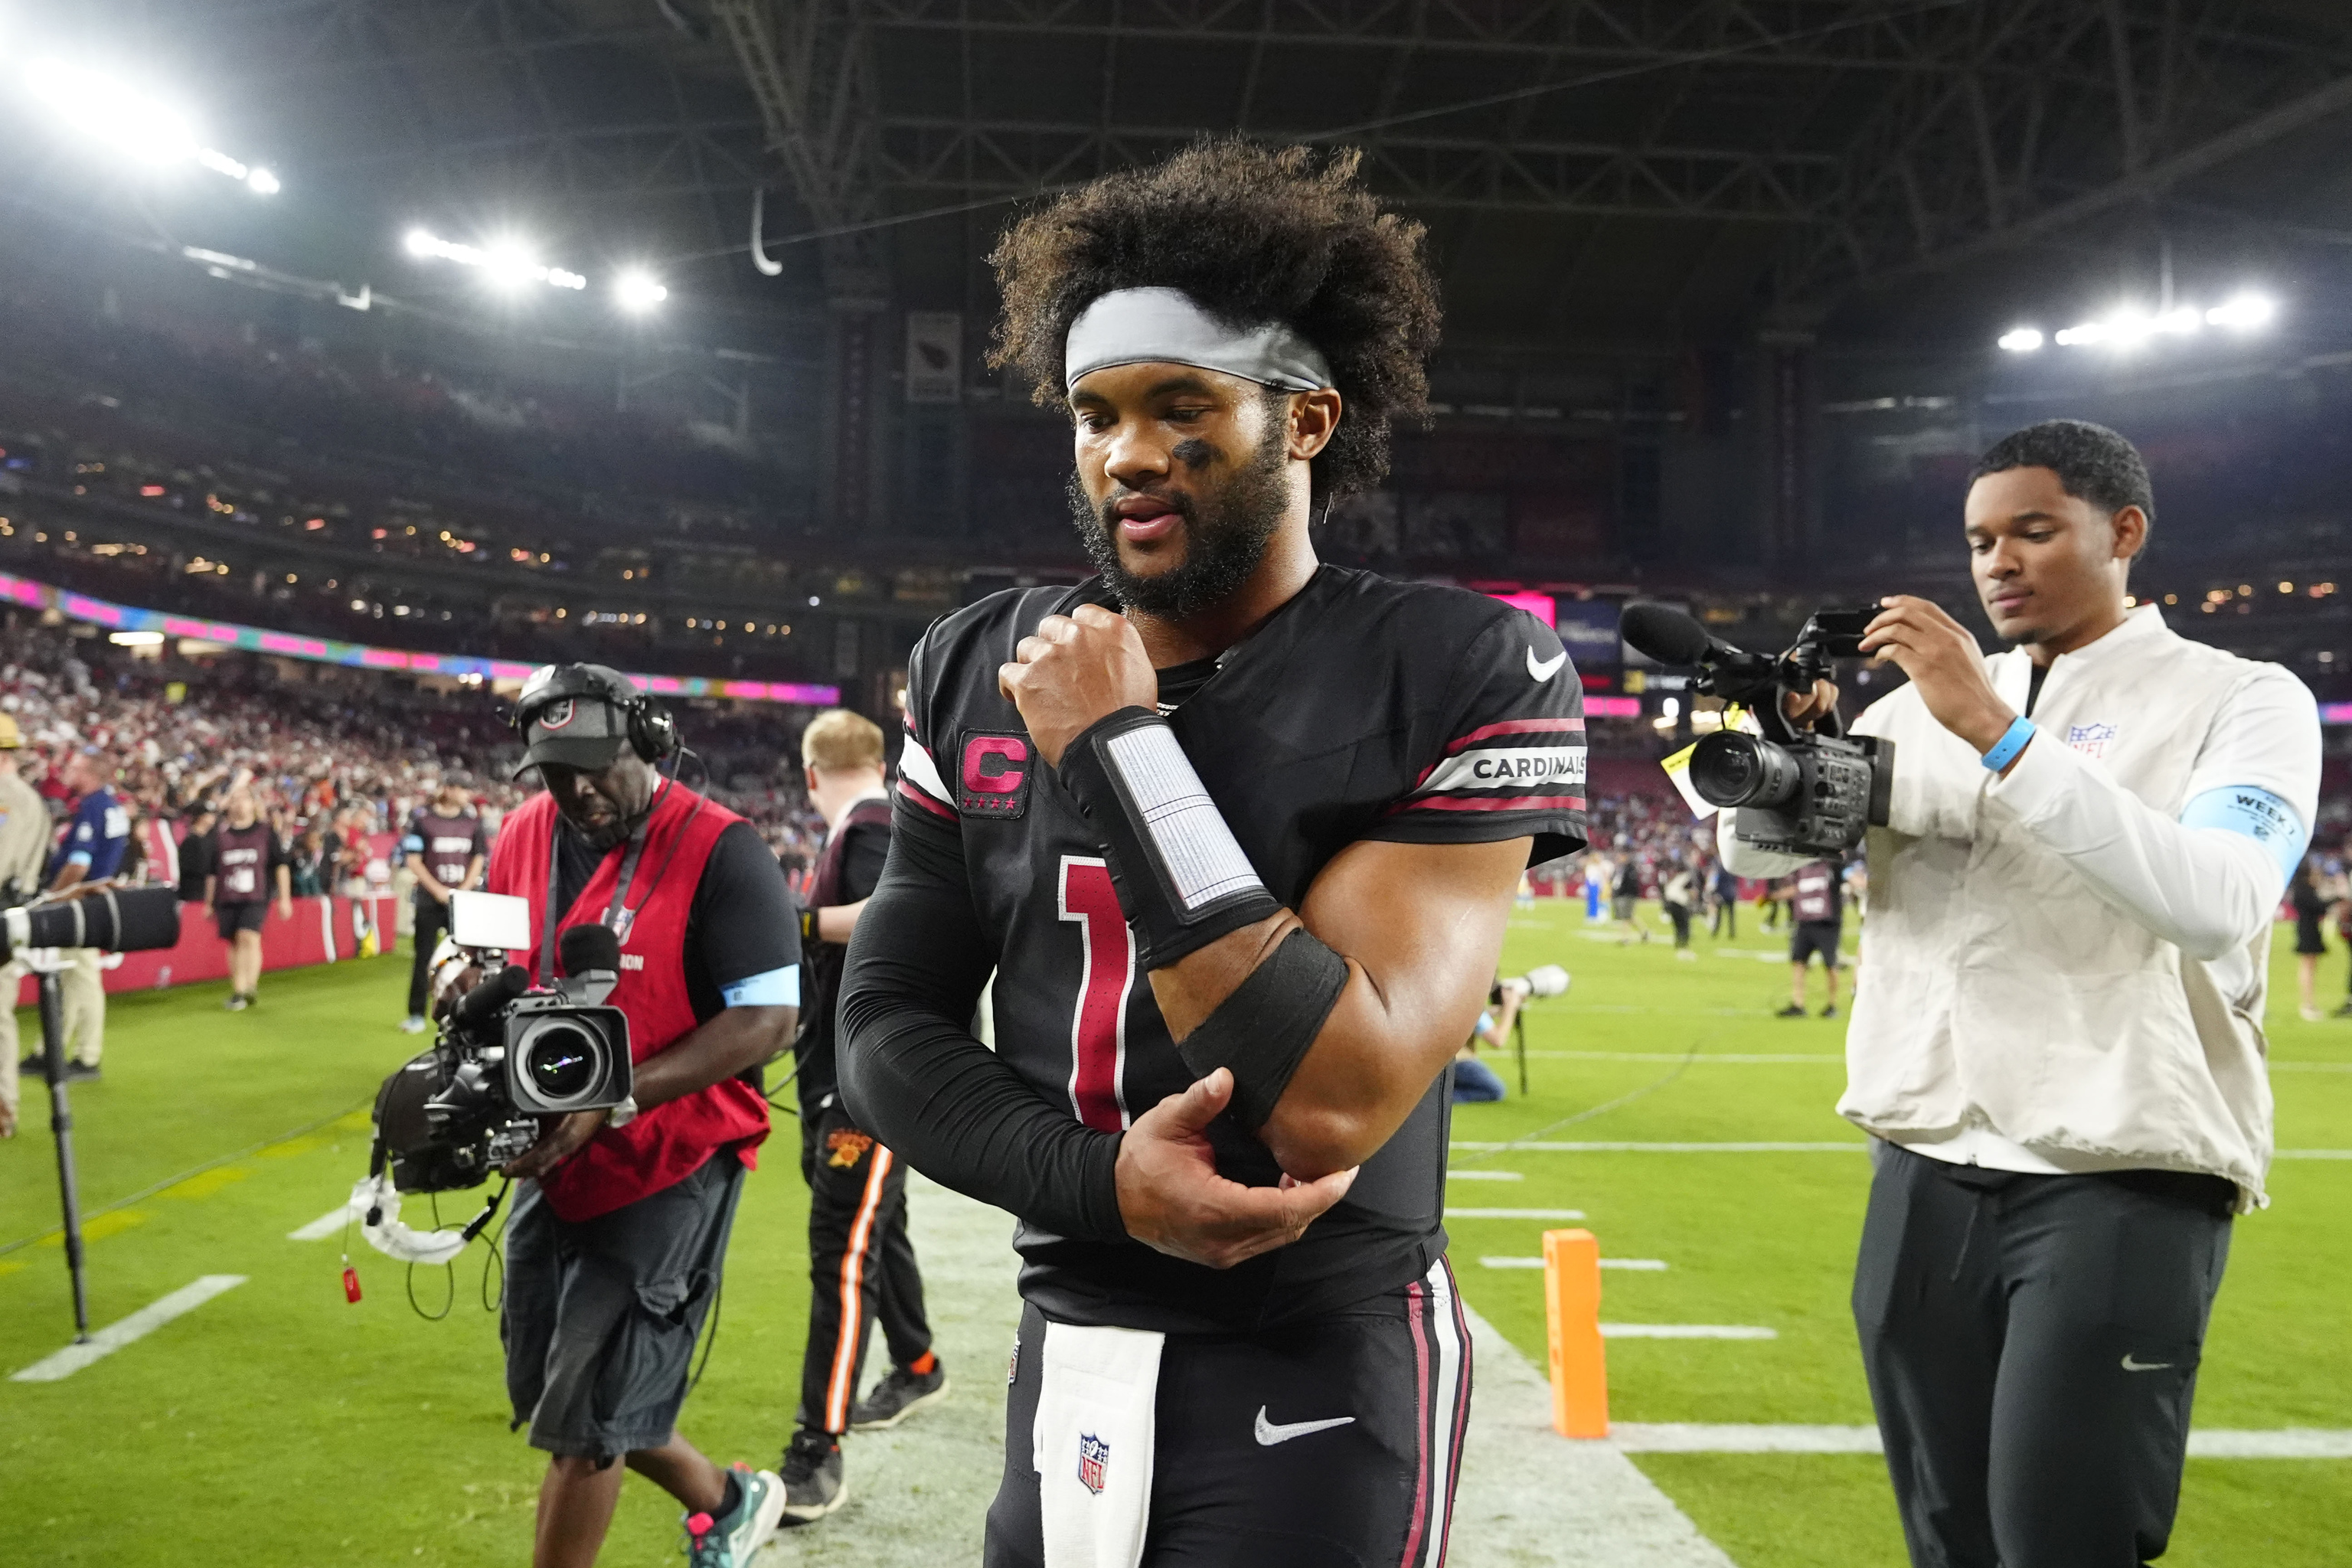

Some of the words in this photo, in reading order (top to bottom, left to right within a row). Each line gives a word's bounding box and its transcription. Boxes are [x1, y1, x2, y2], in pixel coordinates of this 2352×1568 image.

[963, 737, 1027, 793] C
[1473, 756, 1585, 779] CARDINALS
[2236, 794, 2286, 827] WEEK
[1058, 854, 1136, 1137] 1
[1081, 1455, 1105, 1490] NFL
